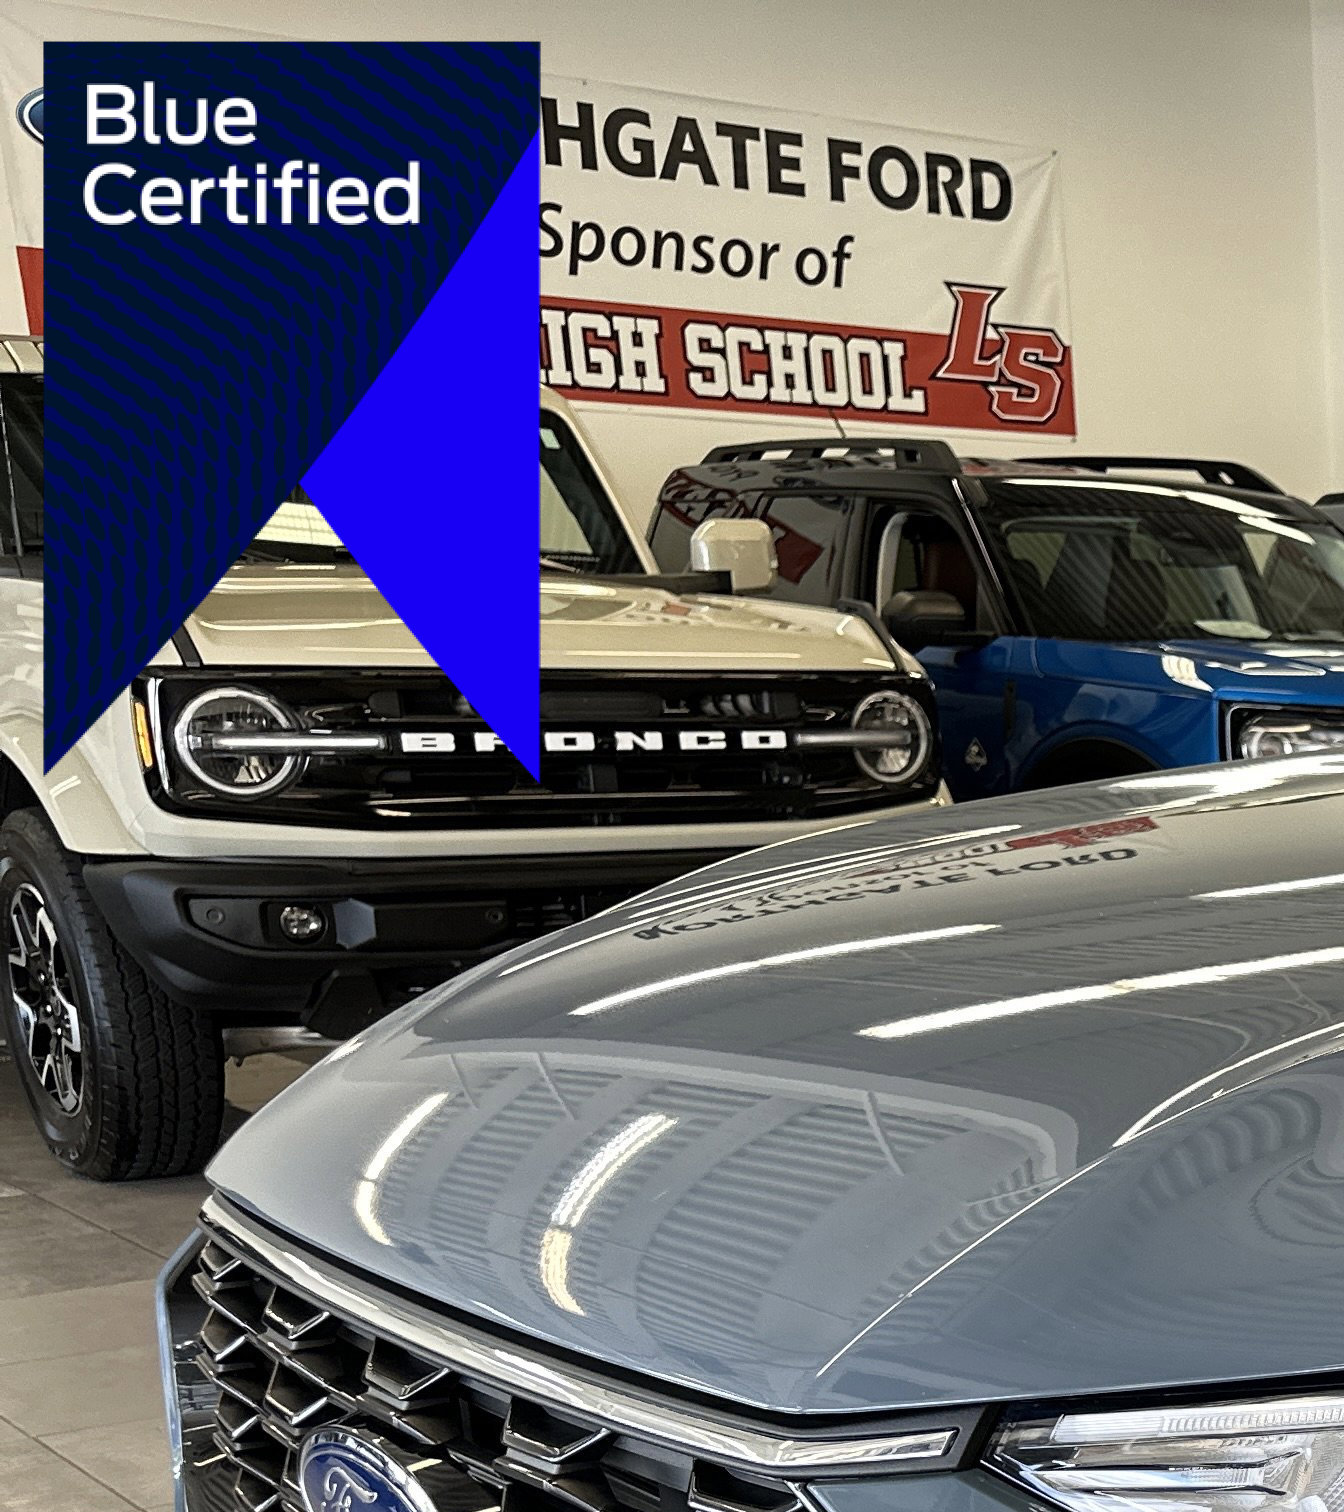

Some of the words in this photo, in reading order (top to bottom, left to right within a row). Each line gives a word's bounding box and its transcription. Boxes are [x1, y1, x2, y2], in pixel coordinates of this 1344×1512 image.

[540, 96, 807, 198] HGATE
[826, 137, 1013, 222] FORD
[539, 202, 779, 280] Sponsor
[795, 235, 855, 288] of
[540, 308, 667, 394] IGH
[681, 321, 927, 415] SCHOOL
